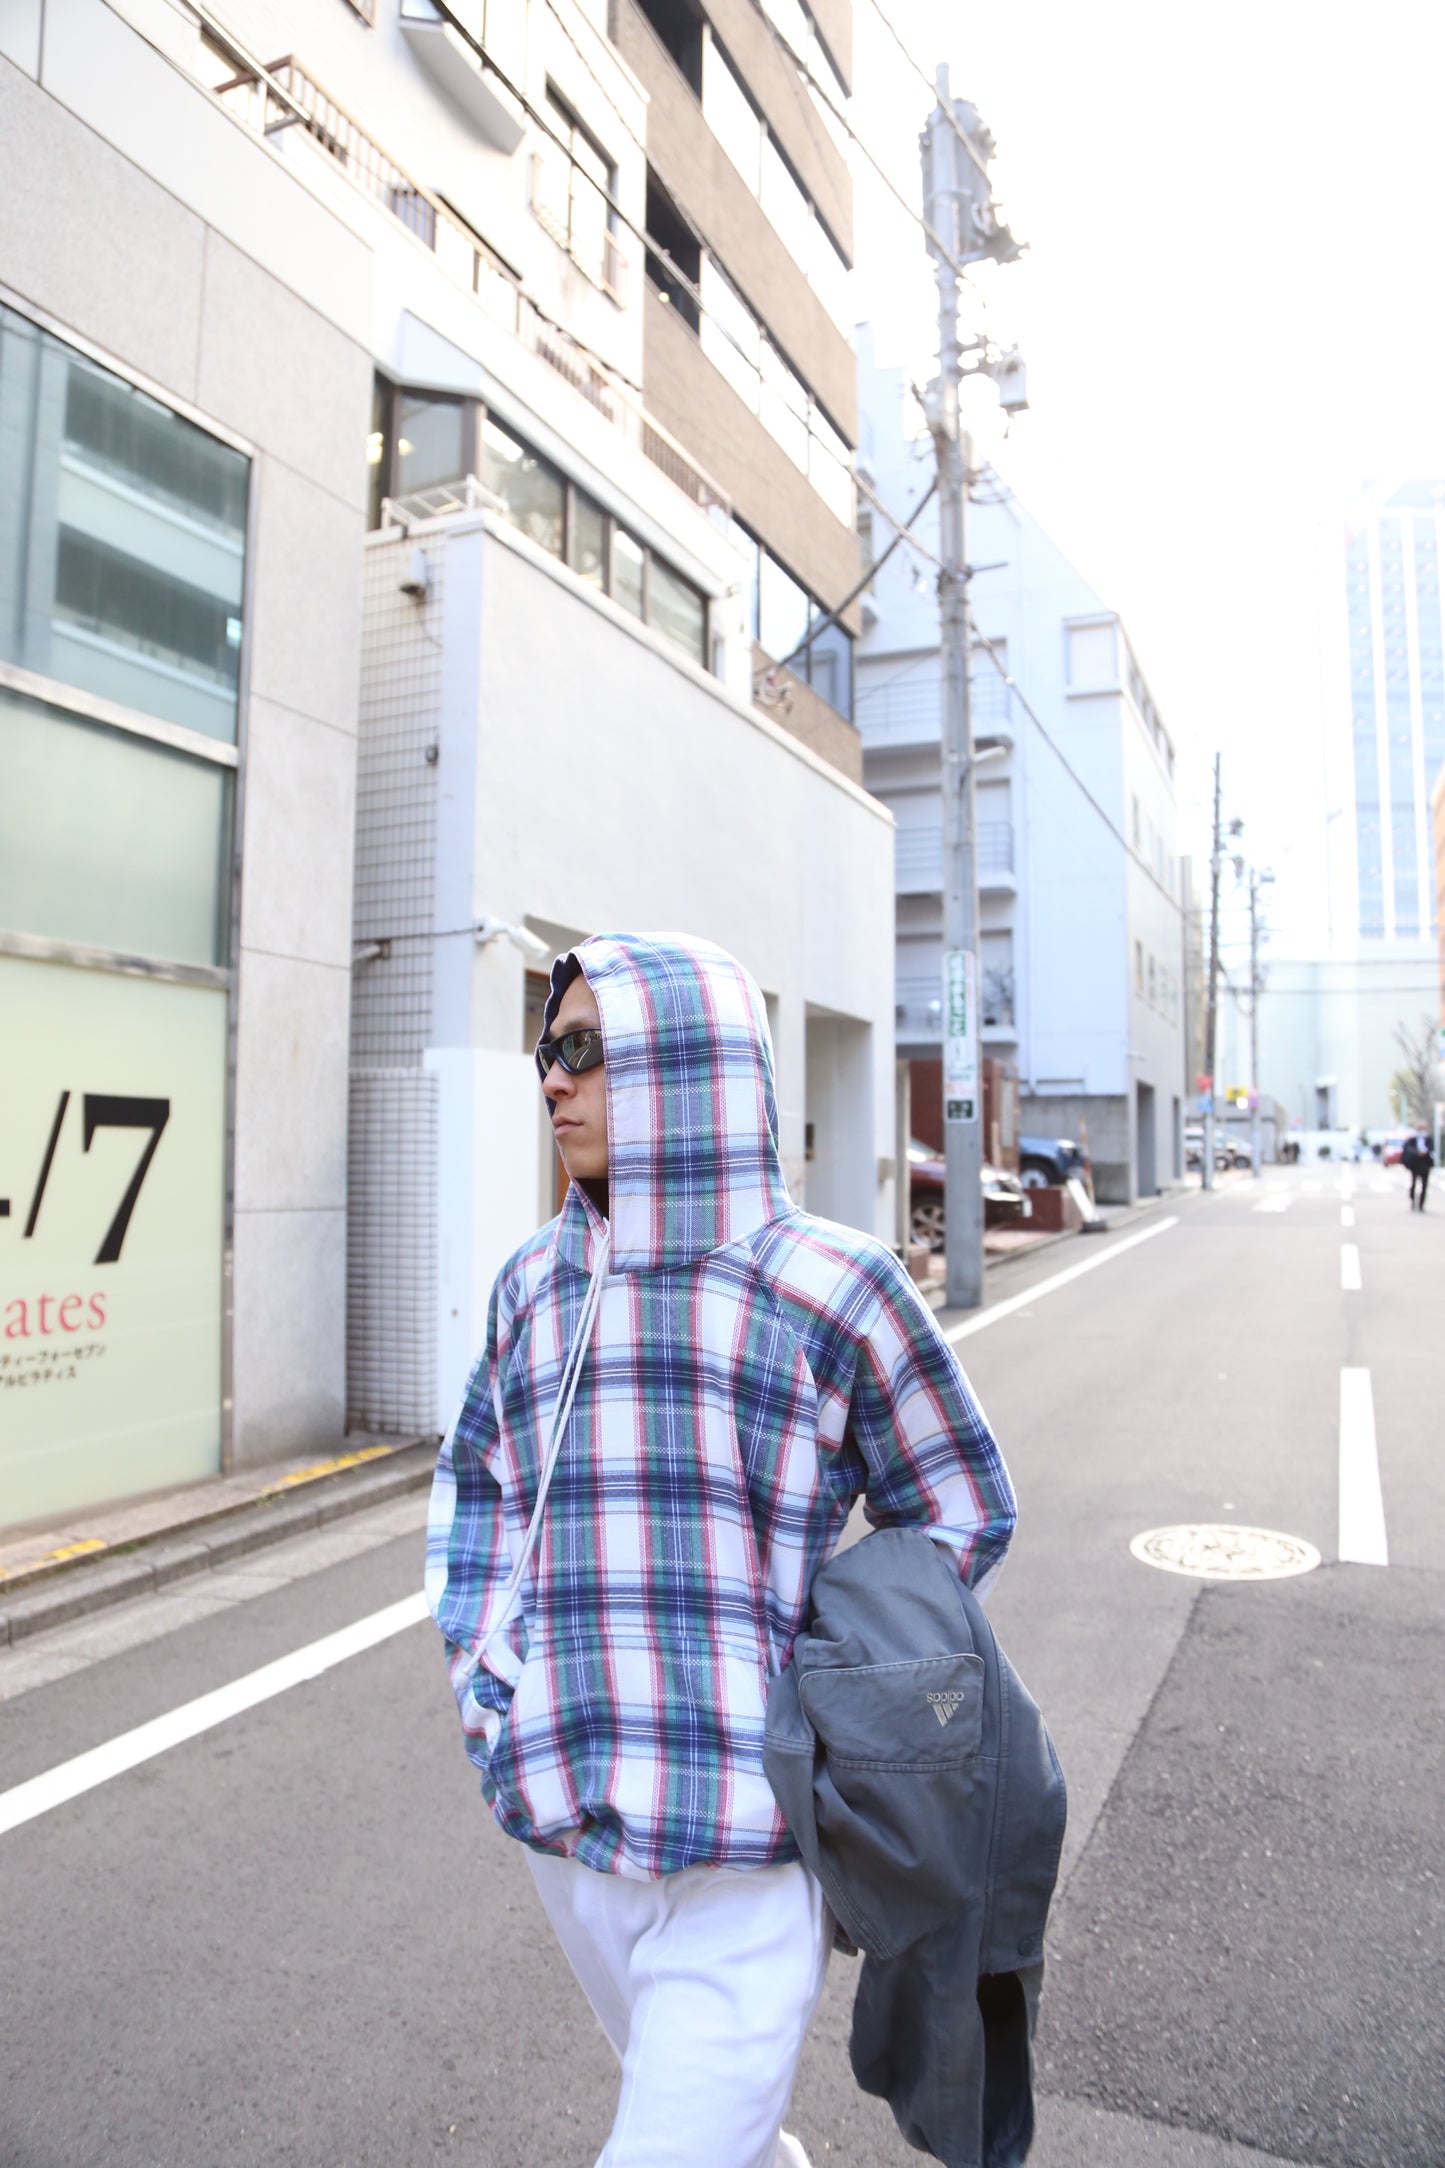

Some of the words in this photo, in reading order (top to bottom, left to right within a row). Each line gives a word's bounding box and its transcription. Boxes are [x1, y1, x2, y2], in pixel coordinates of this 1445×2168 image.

[0, 1090, 170, 1265] /7
[4, 1291, 107, 1339] ates
[926, 1691, 965, 1703] adidas
